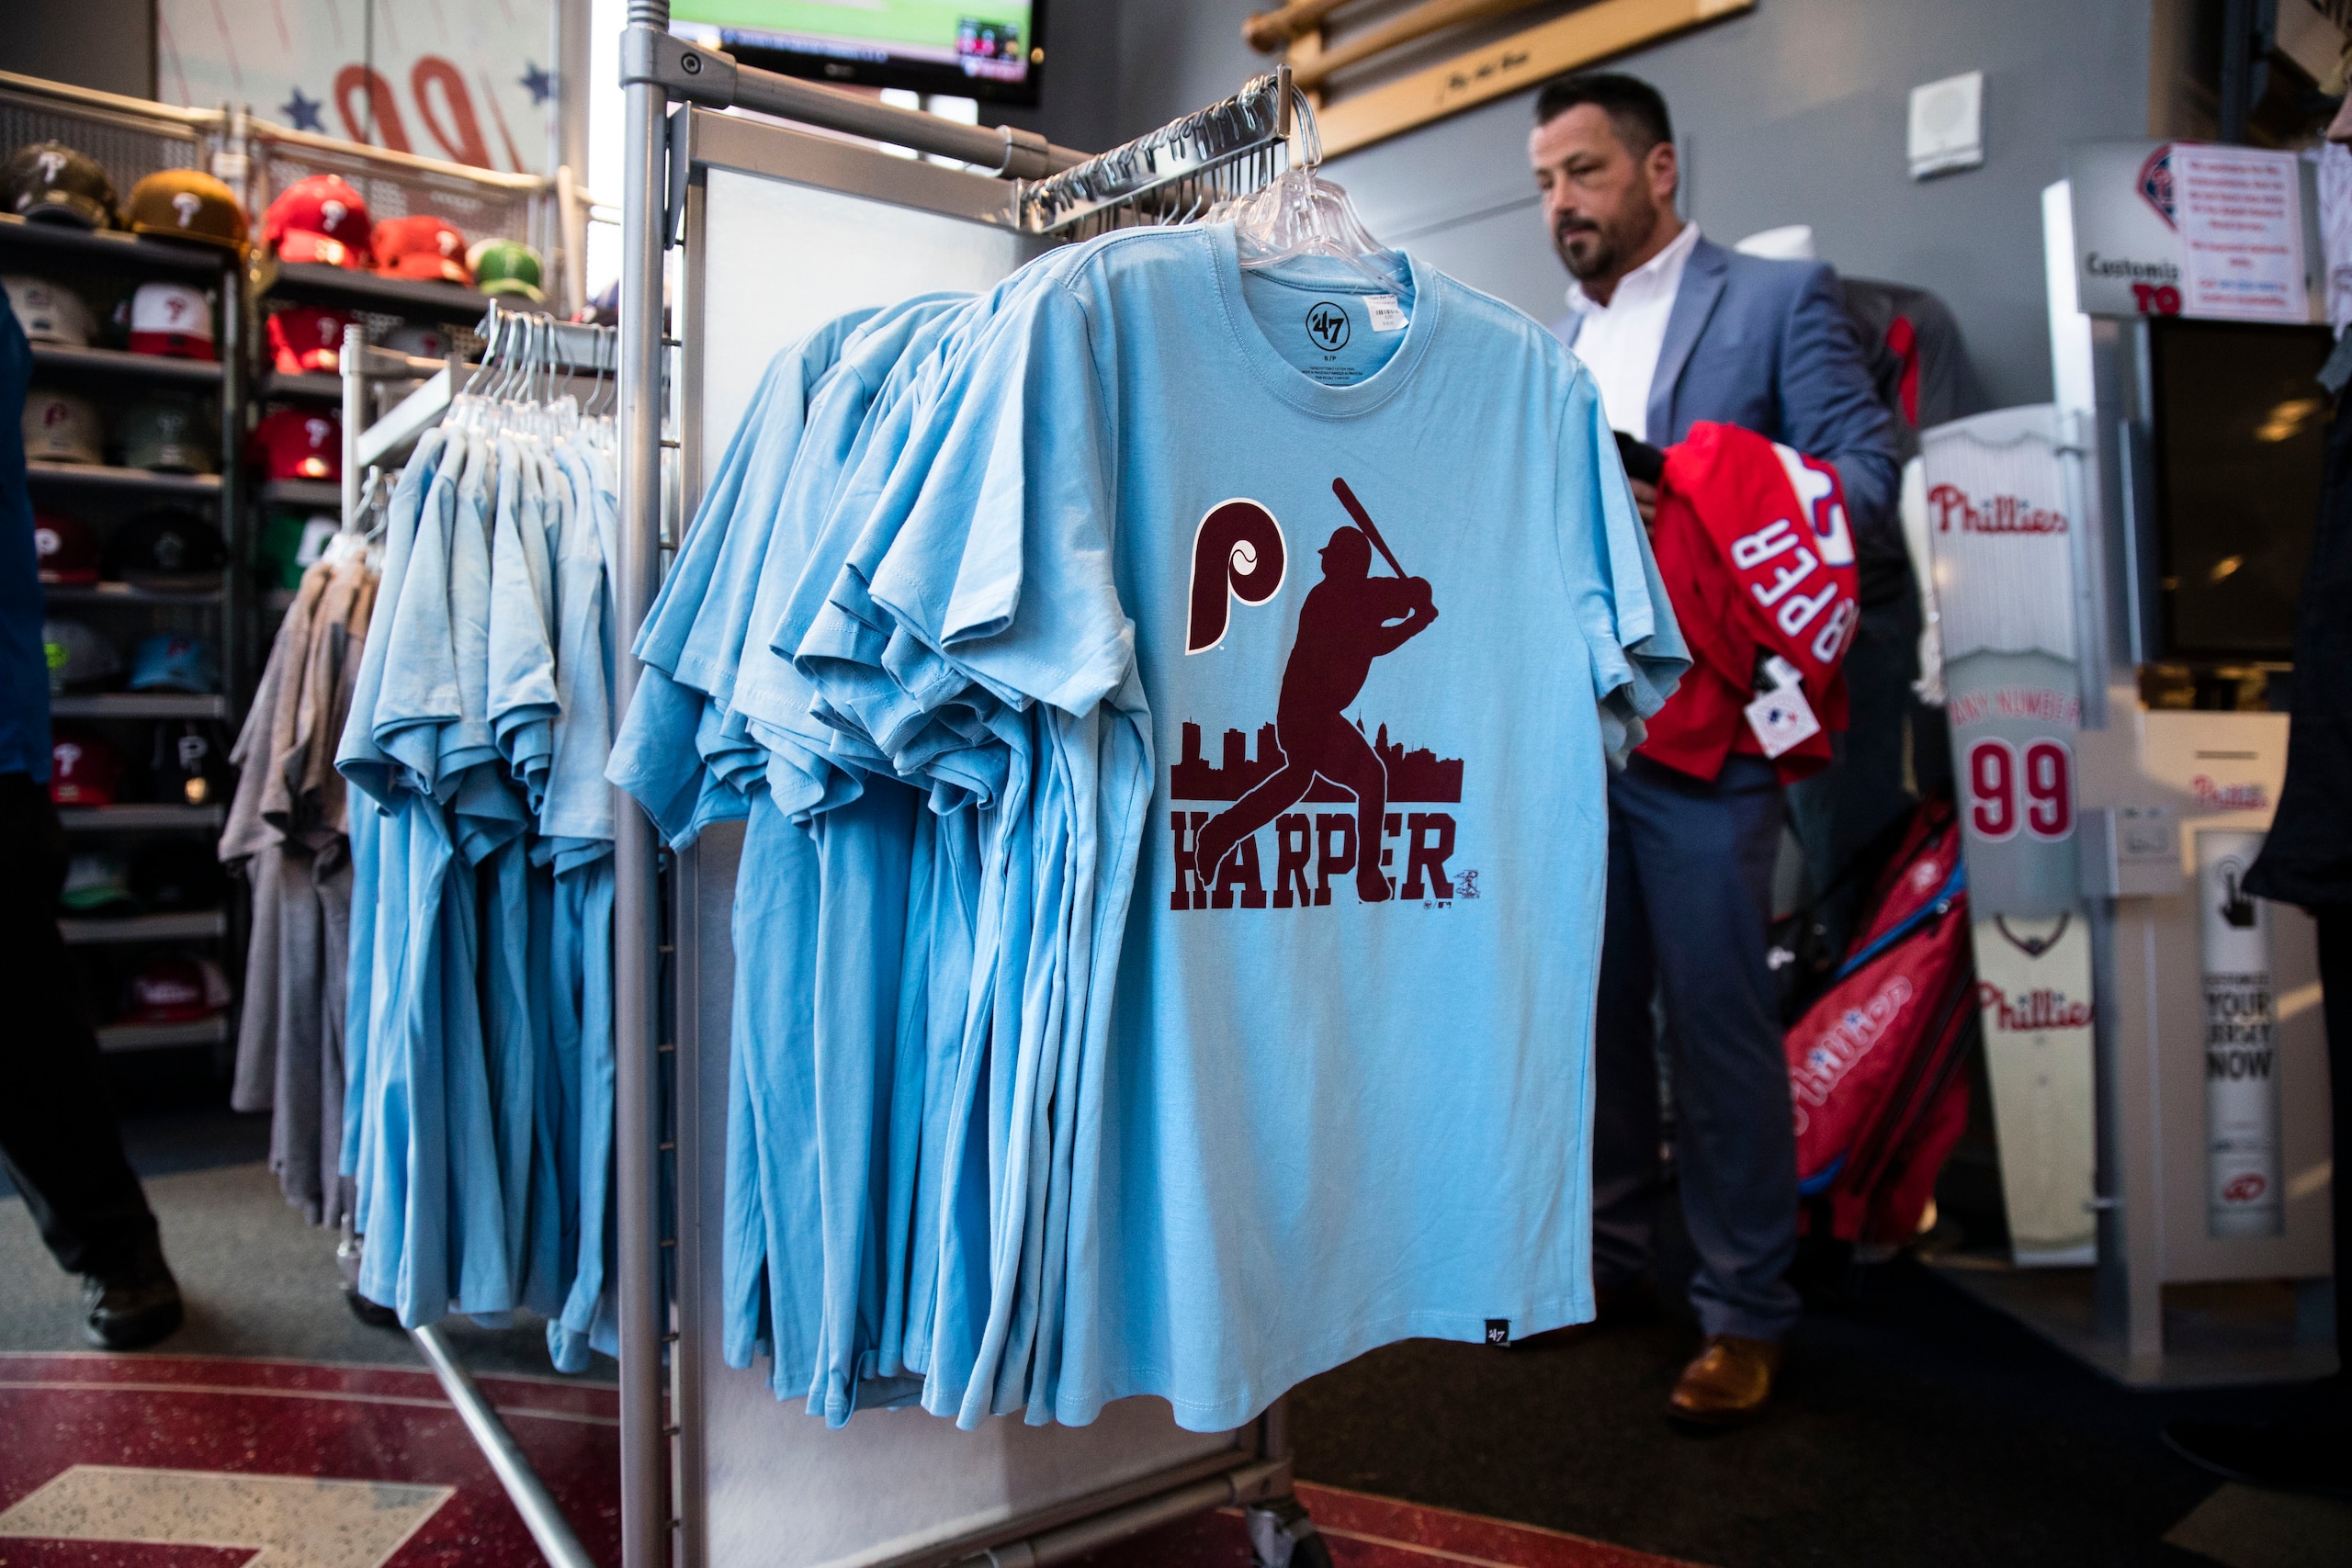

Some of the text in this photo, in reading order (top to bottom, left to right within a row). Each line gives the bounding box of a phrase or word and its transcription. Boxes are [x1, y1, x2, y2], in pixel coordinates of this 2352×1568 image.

[2132, 284, 2181, 316] TO
[1928, 483, 2069, 536] Phillies
[1185, 497, 1287, 656] P
[1731, 518, 1860, 664] RPER
[1967, 739, 2075, 841] 99
[1170, 811, 1457, 910] HARPER
[1976, 981, 2093, 1032] Phillie
[2206, 1051, 2272, 1080] NOW
